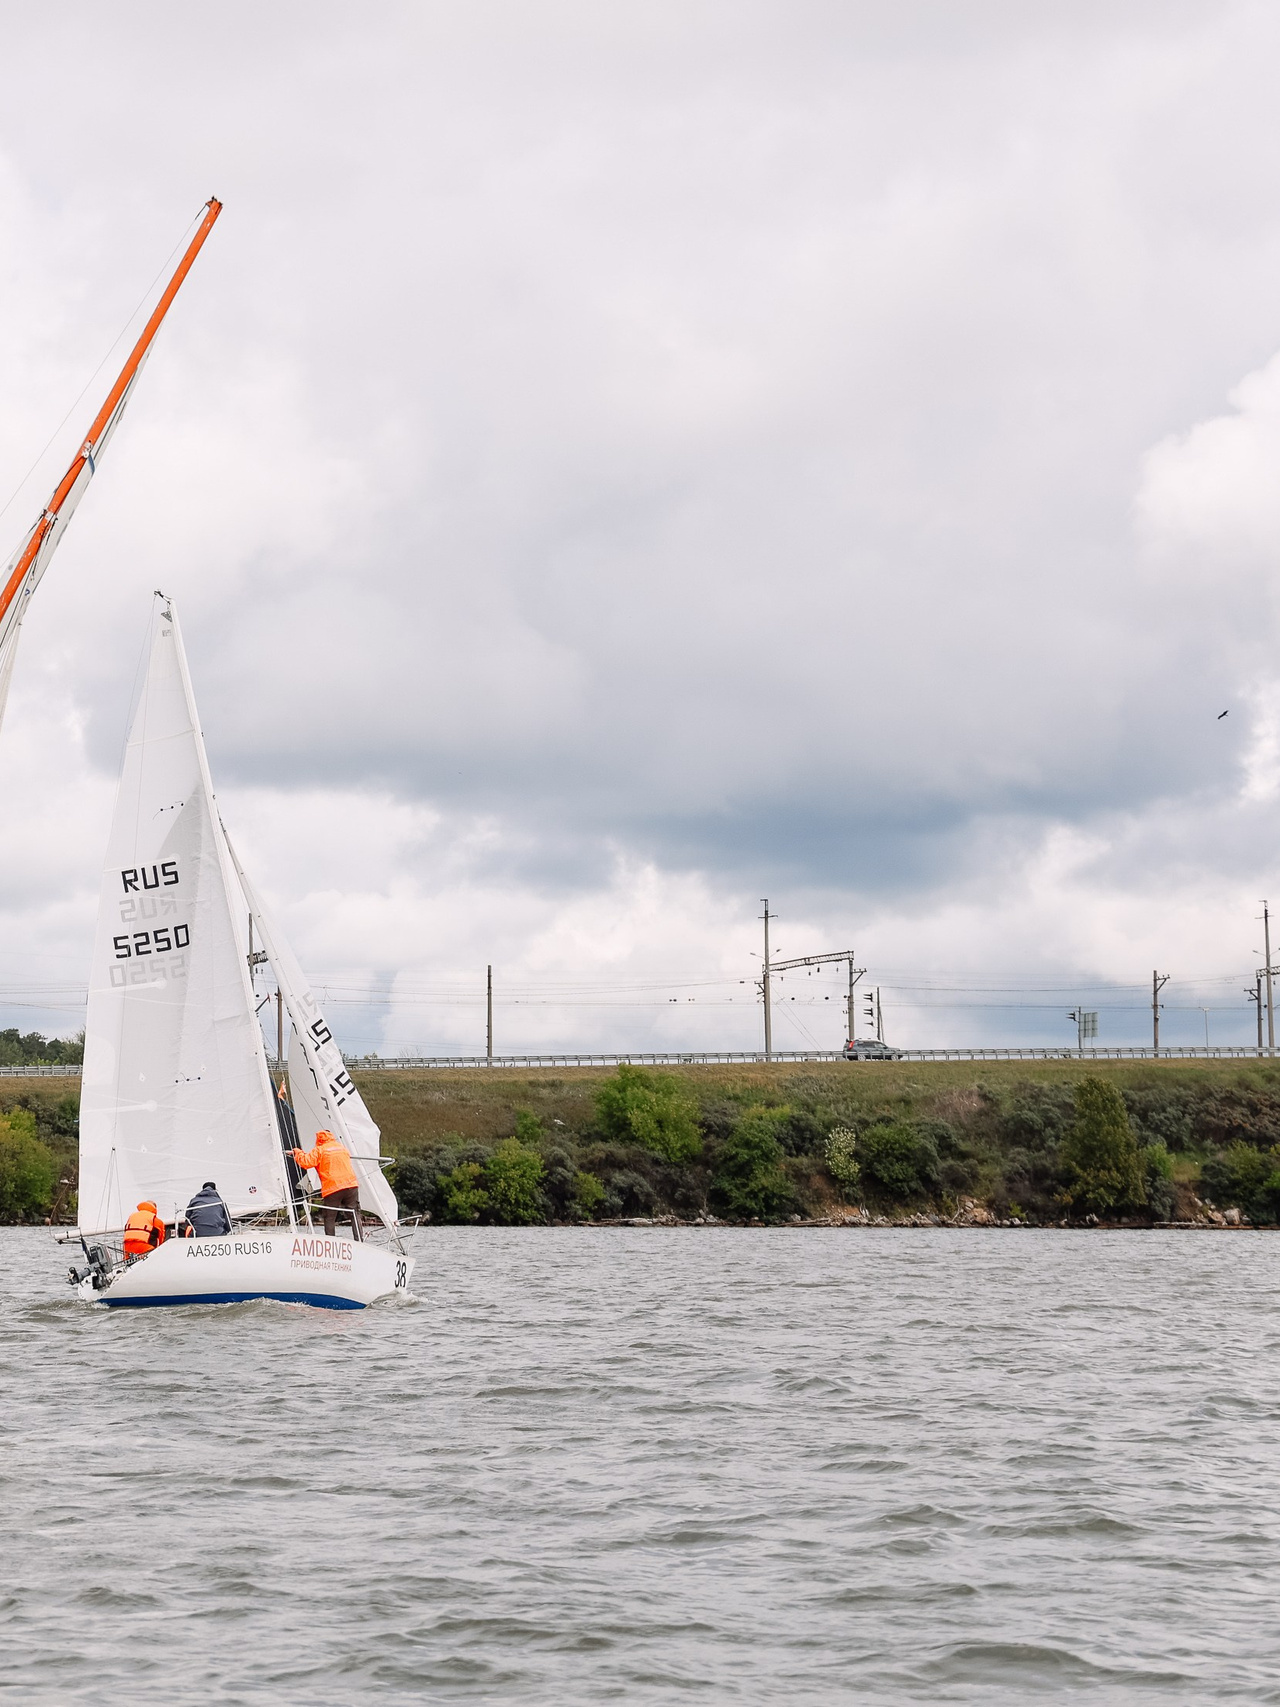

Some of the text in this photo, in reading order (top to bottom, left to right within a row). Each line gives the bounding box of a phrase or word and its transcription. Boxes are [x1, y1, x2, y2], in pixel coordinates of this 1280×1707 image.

[121, 861, 180, 893] RUS
[113, 924, 190, 959] 5250
[187, 1241, 272, 1258] AA5250 RUS16
[291, 1238, 353, 1261] AMDRIVES
[290, 1259, 352, 1273] ПРИВОДНАЯ ТЕХНИКА
[394, 1260, 407, 1288] 38
